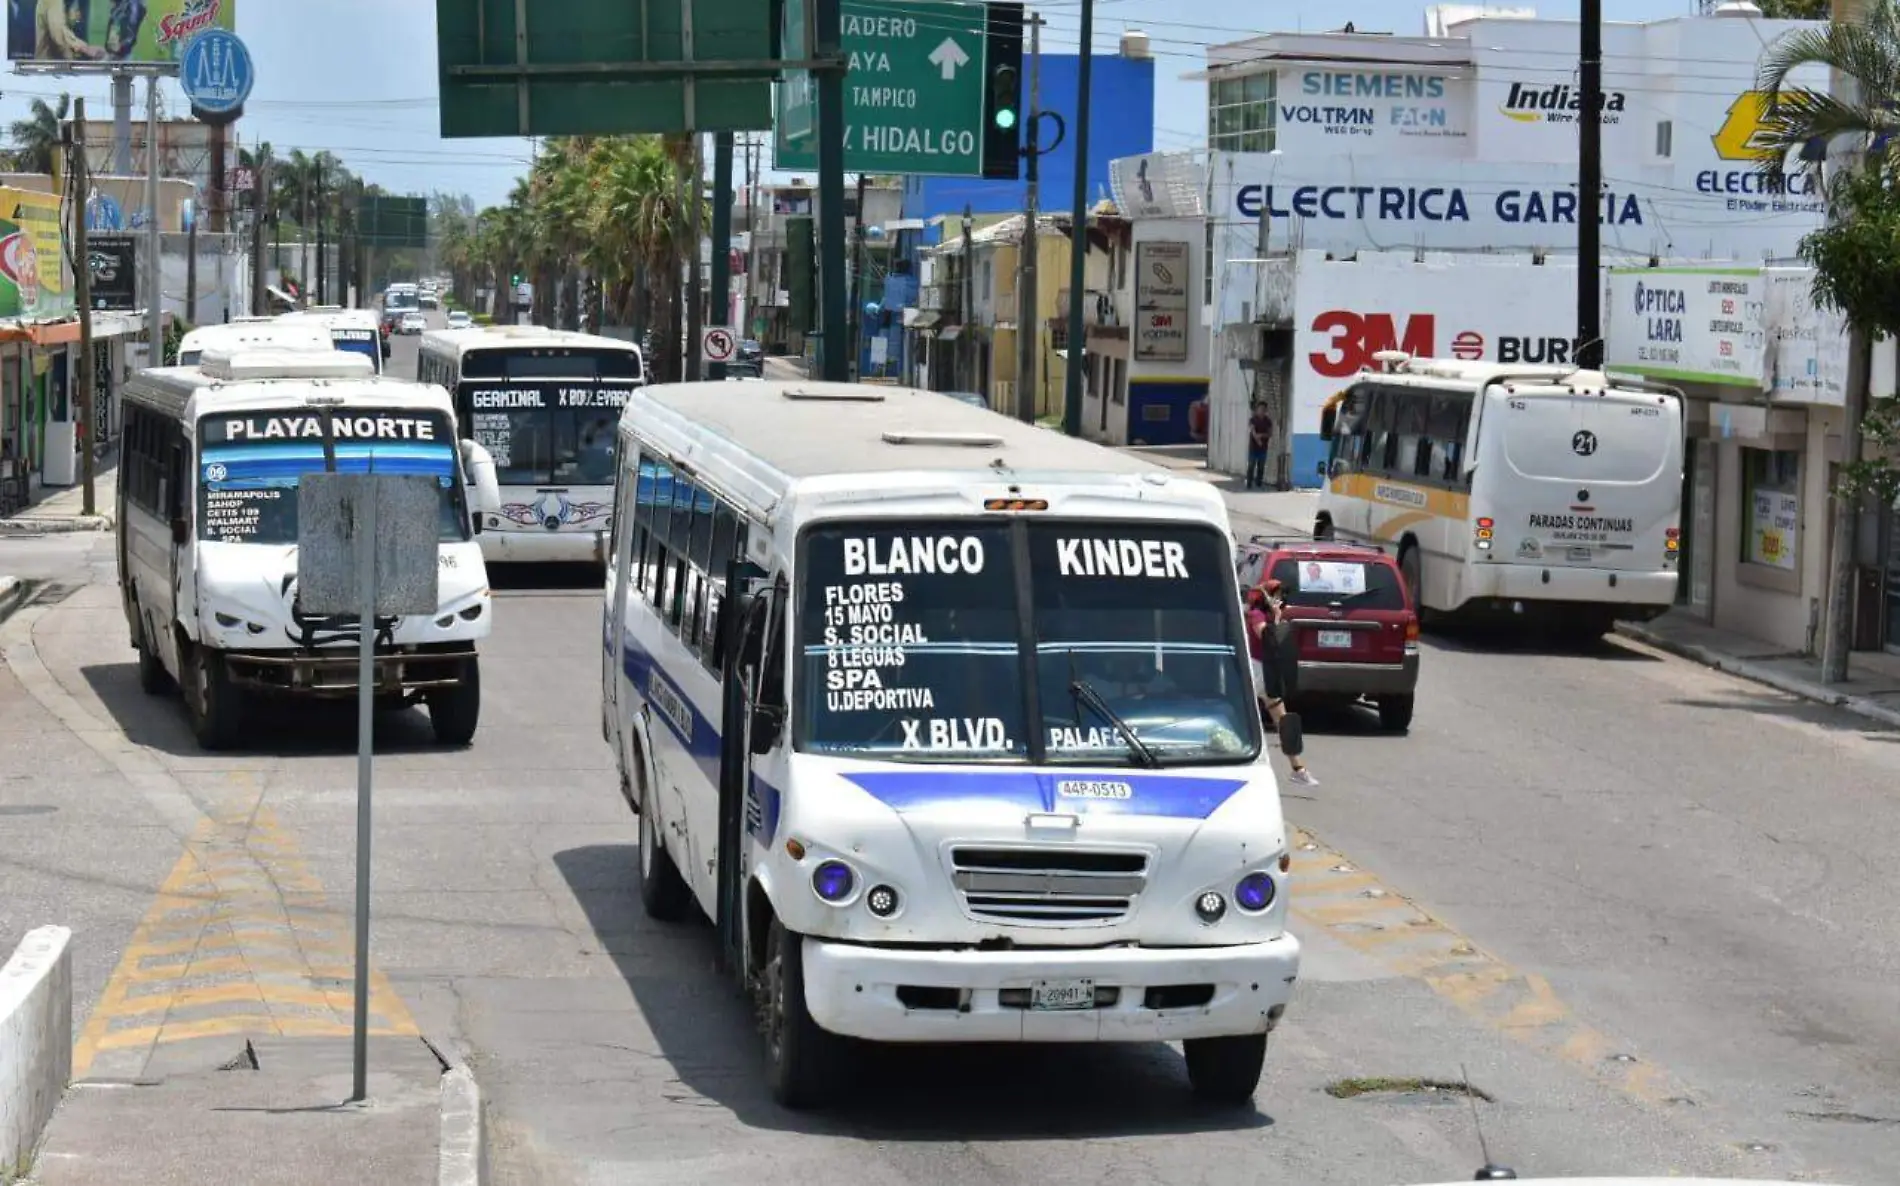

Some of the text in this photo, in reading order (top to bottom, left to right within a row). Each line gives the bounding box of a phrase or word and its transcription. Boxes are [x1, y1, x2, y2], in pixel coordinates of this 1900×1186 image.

[841, 18, 915, 37] ADERO
[1303, 72, 1444, 98] SIEMENS
[853, 87, 915, 108] TAMPICO
[1281, 106, 1374, 124] VOLTRAN
[863, 127, 973, 155] HIDALGO
[1237, 184, 1469, 221] ELECTRICA
[1495, 189, 1642, 225] GARIA
[1648, 319, 1682, 342] LARA
[1309, 310, 1434, 377] 3M
[473, 390, 546, 408] GERMINAL
[559, 389, 567, 406] X
[226, 418, 434, 440] PLAYA NORTE
[1576, 434, 1596, 454] 21
[207, 517, 259, 526] WALMART
[219, 526, 257, 535] SOCIAL
[1529, 514, 1632, 532] PARADAS CONTINUAS
[843, 536, 1189, 579] BLANCO KINDER
[825, 582, 904, 605] FLORES
[825, 603, 893, 626] 15 MAYO
[824, 623, 929, 647] S. SOCIAL
[828, 646, 905, 668] 8 LEGUAS
[827, 669, 882, 690] SPA
[827, 688, 934, 712] U.DEPORTIVA
[901, 718, 1014, 750] X BLVD.
[1063, 782, 1127, 797] 44P-0513
